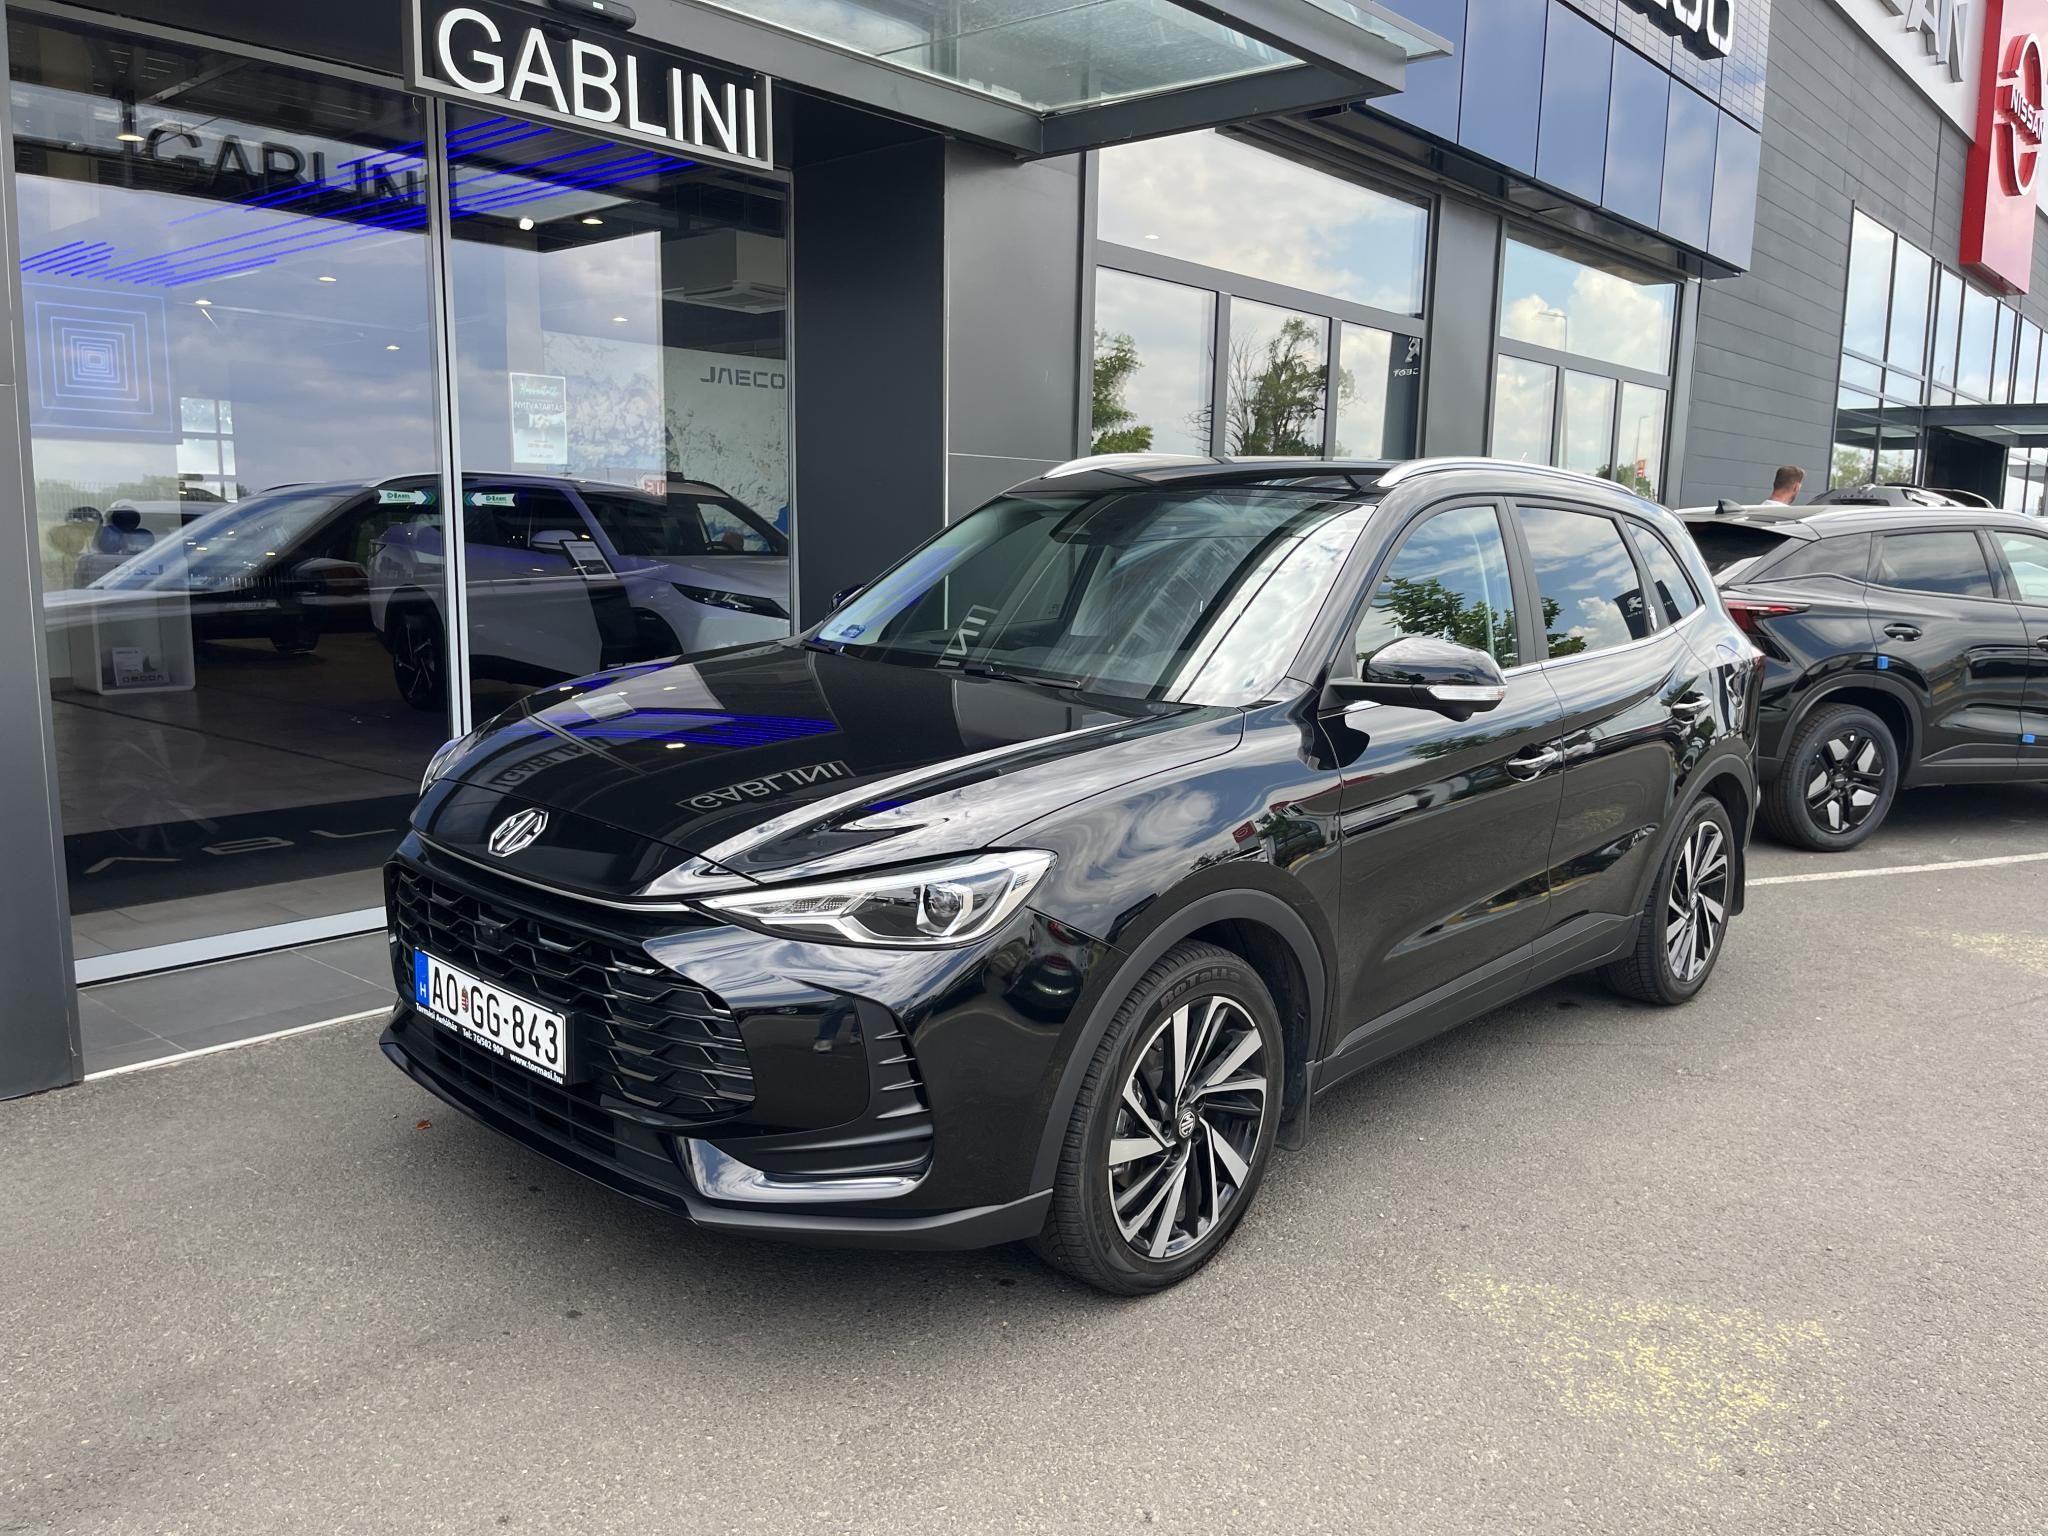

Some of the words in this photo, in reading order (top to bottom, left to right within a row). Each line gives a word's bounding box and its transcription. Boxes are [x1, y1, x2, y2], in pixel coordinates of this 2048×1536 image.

[438, 7, 757, 158] GABLINI
[2011, 88, 2044, 142] NISSAN
[491, 810, 546, 855] MG
[419, 981, 427, 998] H
[432, 966, 459, 1016] AO
[510, 1053, 564, 1085] www.tormasi.hu
